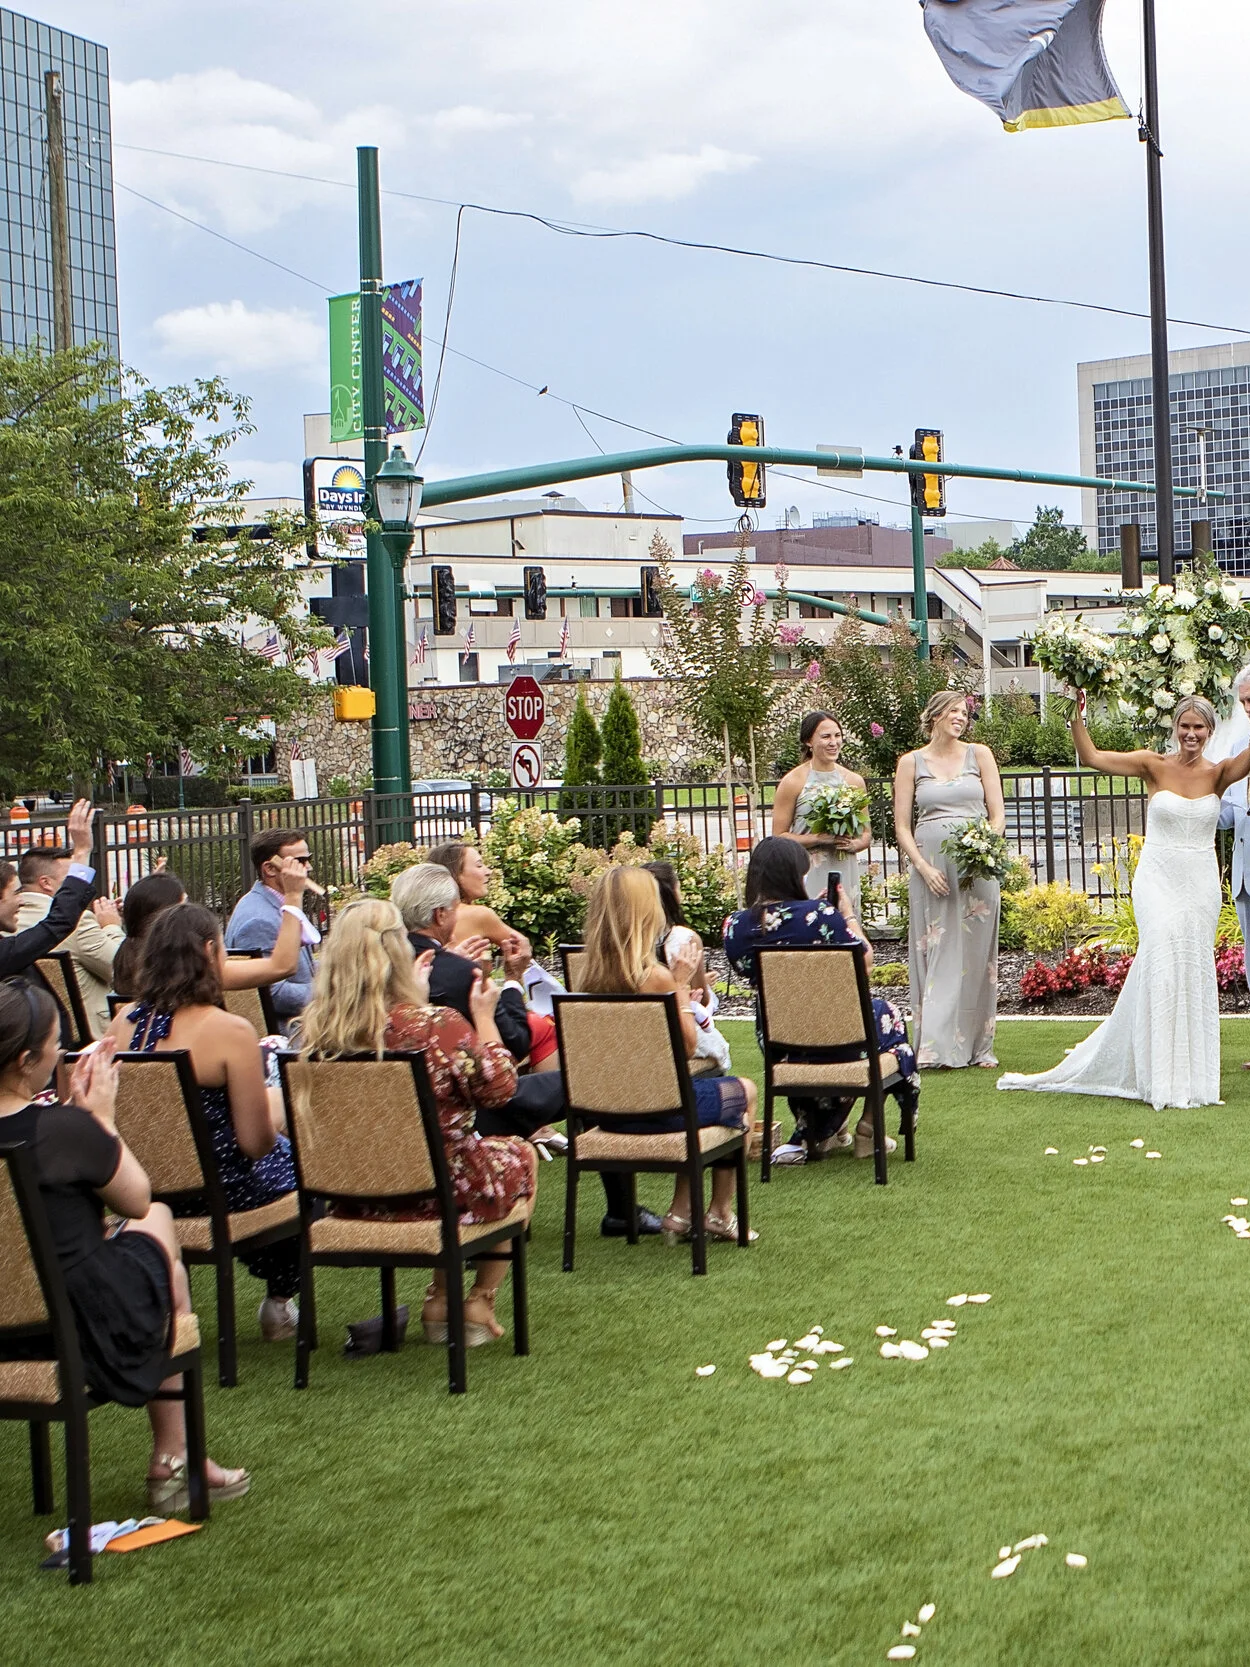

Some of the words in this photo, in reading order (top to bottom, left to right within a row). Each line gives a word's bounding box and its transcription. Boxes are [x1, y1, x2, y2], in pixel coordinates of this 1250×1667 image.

[351, 299, 362, 380] CENTER
[351, 387, 362, 432] CITY
[320, 489, 353, 504] Days
[408, 703, 438, 720] NER
[508, 696, 543, 720] STOP
